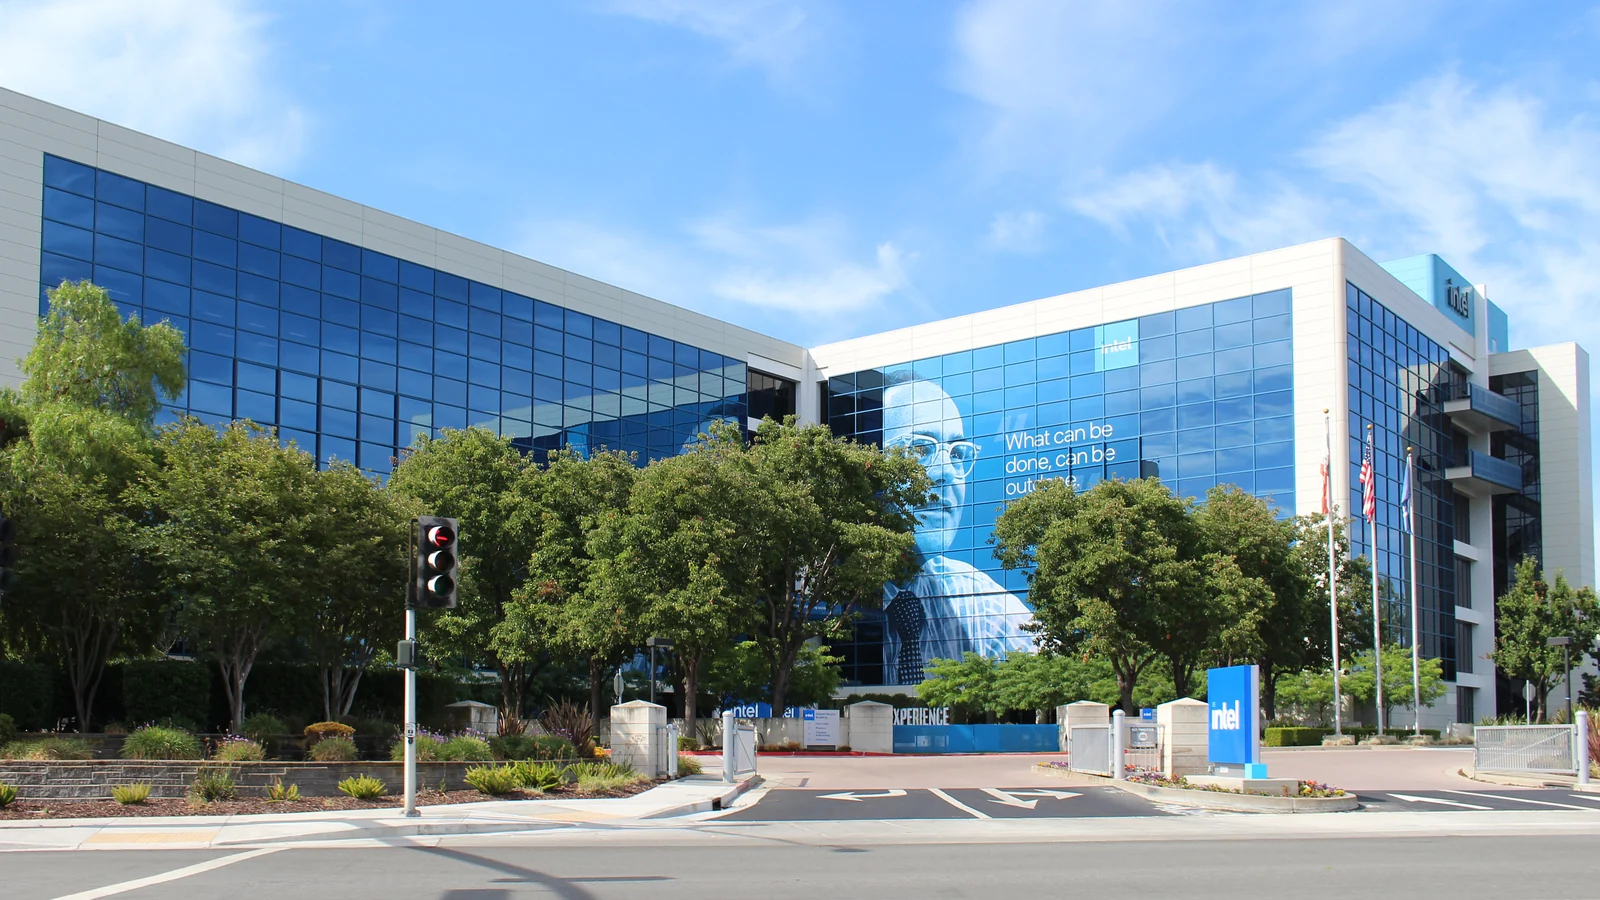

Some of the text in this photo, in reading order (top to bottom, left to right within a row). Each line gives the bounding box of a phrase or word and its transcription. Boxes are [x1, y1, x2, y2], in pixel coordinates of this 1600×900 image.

[1101, 336, 1132, 355] intel
[1005, 421, 1113, 450] What can be
[1005, 445, 1116, 474] done, can be
[1005, 473, 1080, 495] outde.
[731, 702, 758, 718] ntel
[893, 706, 950, 726] XPERIENCE
[1212, 700, 1240, 730] intel
